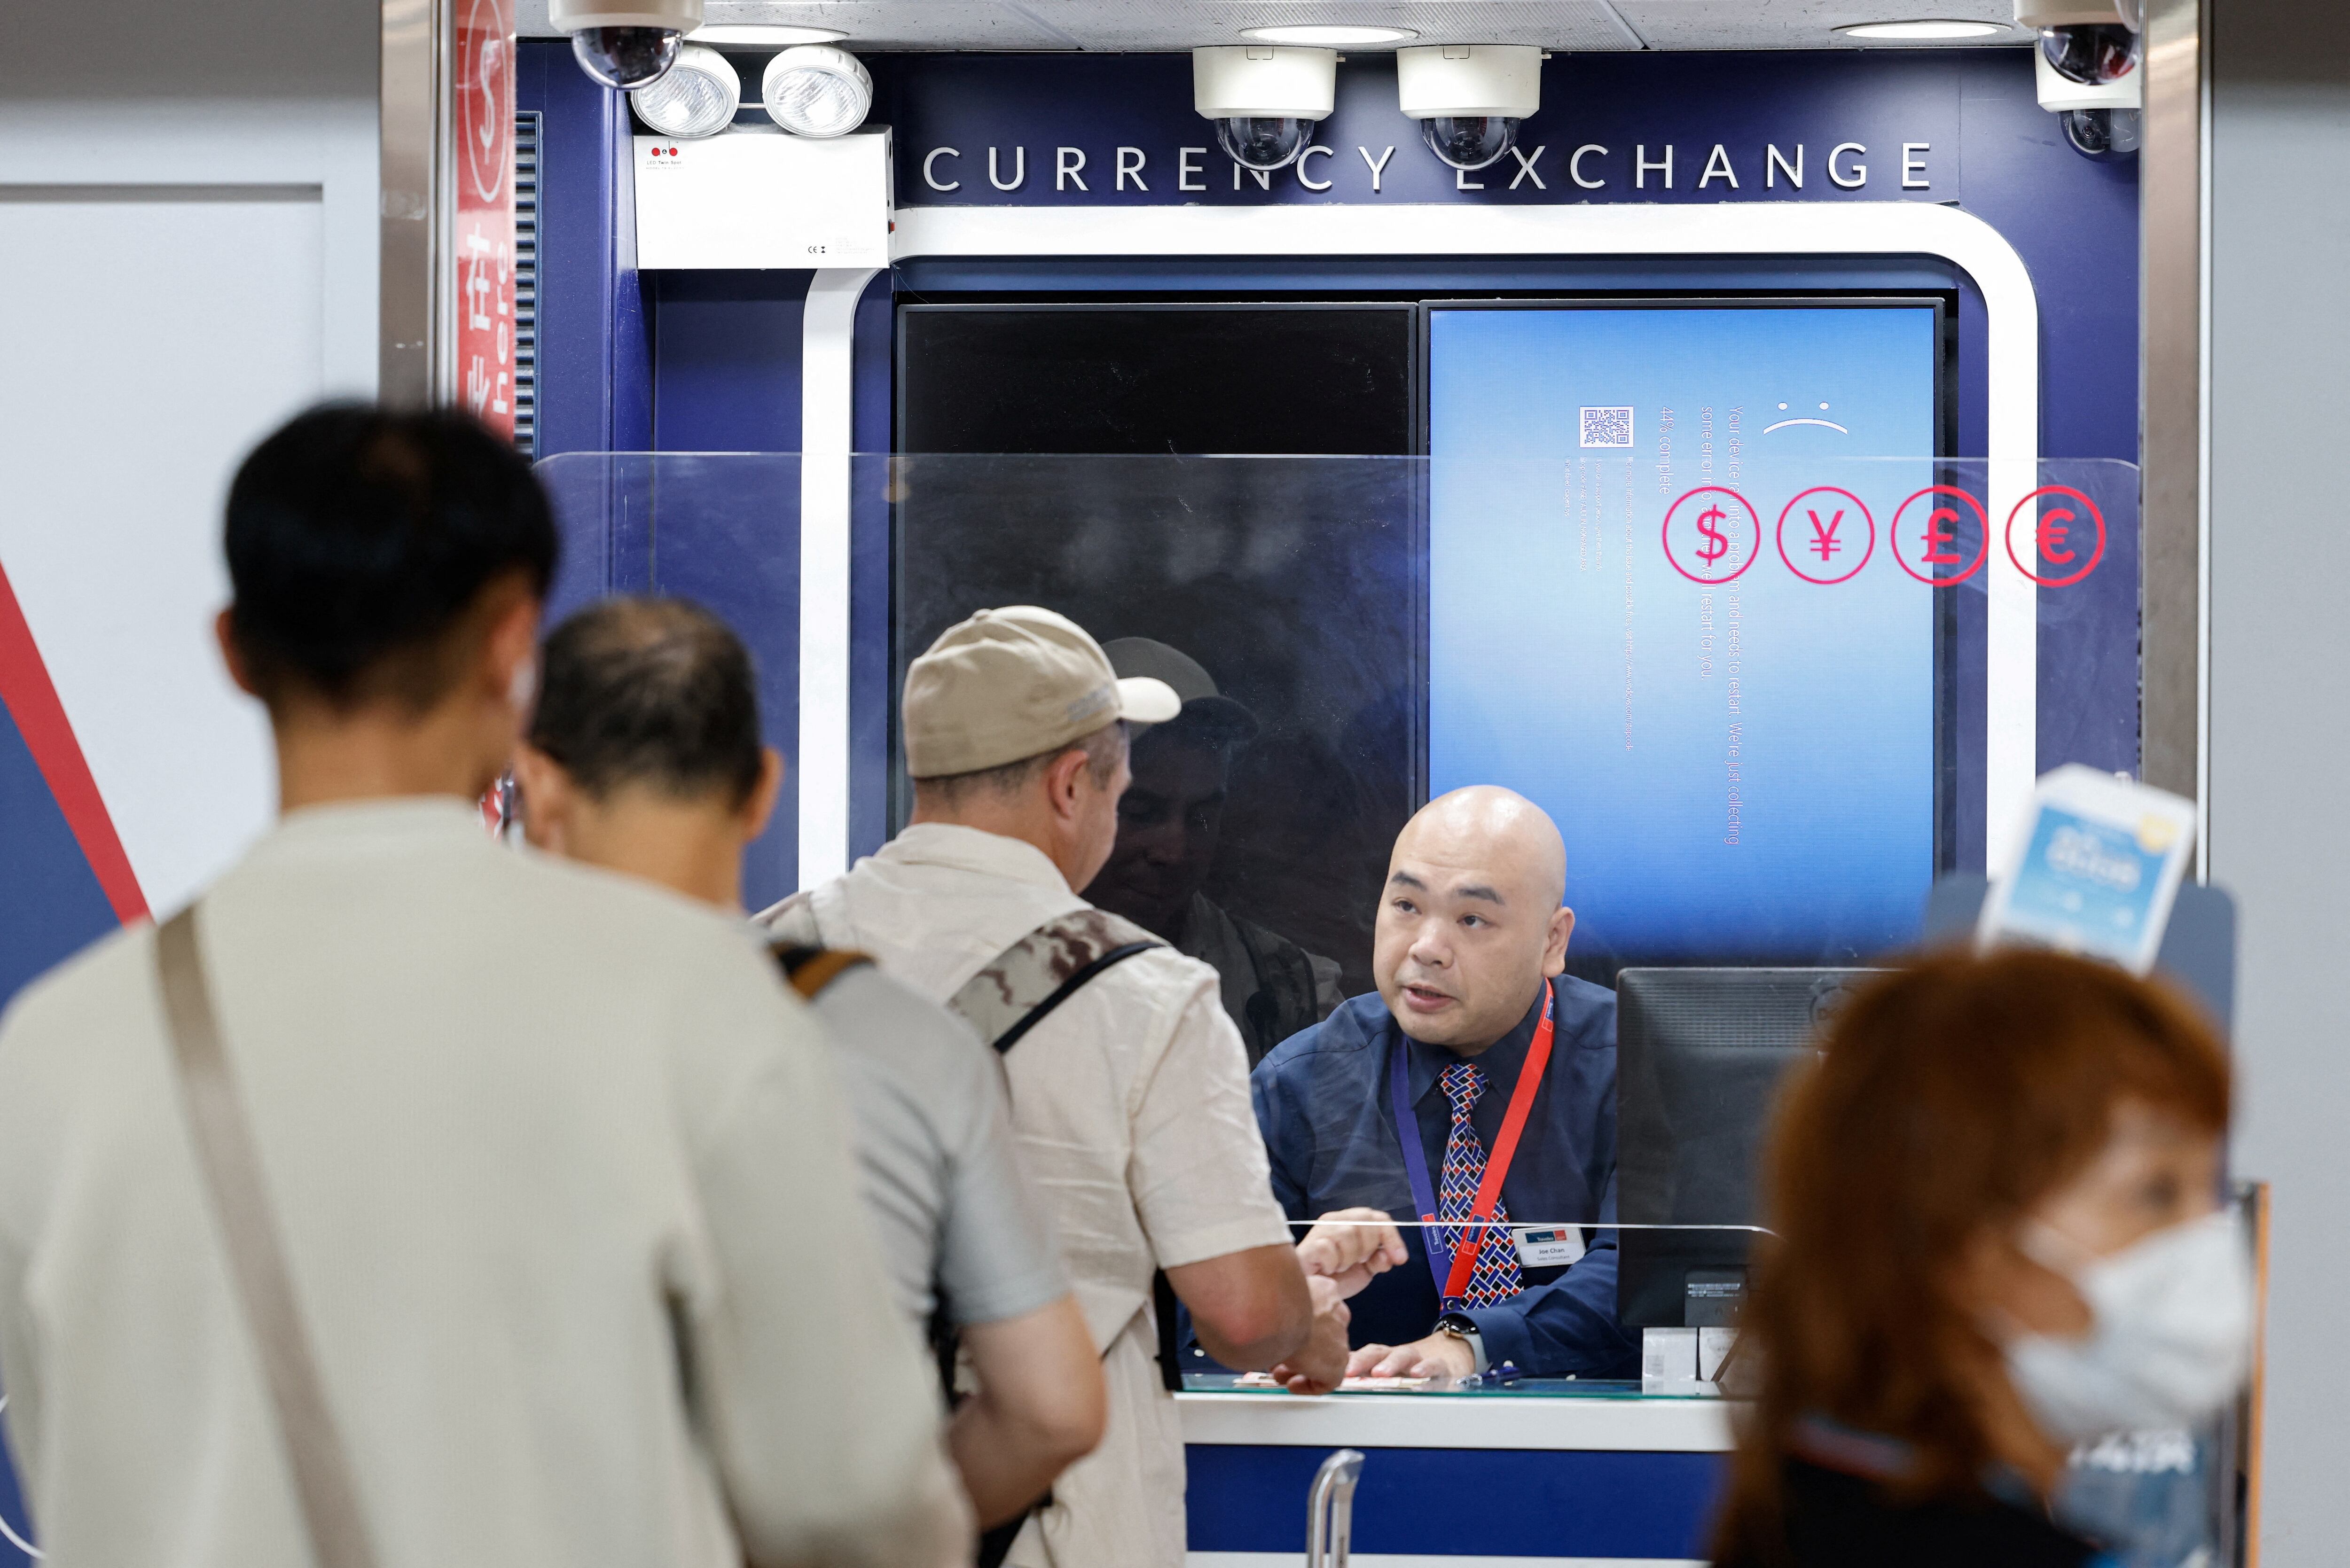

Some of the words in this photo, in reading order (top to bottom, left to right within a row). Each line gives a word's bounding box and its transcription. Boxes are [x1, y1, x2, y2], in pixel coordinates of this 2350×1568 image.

[923, 146, 1395, 191] CURRENCY
[1660, 406, 1675, 433] 44%
[1701, 406, 1713, 439] some
[1729, 406, 1743, 435] Your
[1655, 436, 1675, 495] complete
[1701, 442, 1713, 474] error
[1729, 438, 1744, 478] device
[1699, 477, 1716, 502] ino,
[1729, 505, 1743, 529] into
[1701, 564, 1716, 590] well
[1624, 585, 1634, 609] possible
[1701, 593, 1715, 630] restart
[1729, 595, 1744, 617] and
[1701, 634, 1716, 651] for
[1729, 622, 1744, 657] needs
[1697, 655, 1713, 680] you.
[1729, 661, 1742, 673] to
[1729, 677, 1741, 718] restart.
[1729, 722, 1743, 757] We're
[1724, 760, 1743, 782] just
[1723, 786, 1743, 845] collecting
